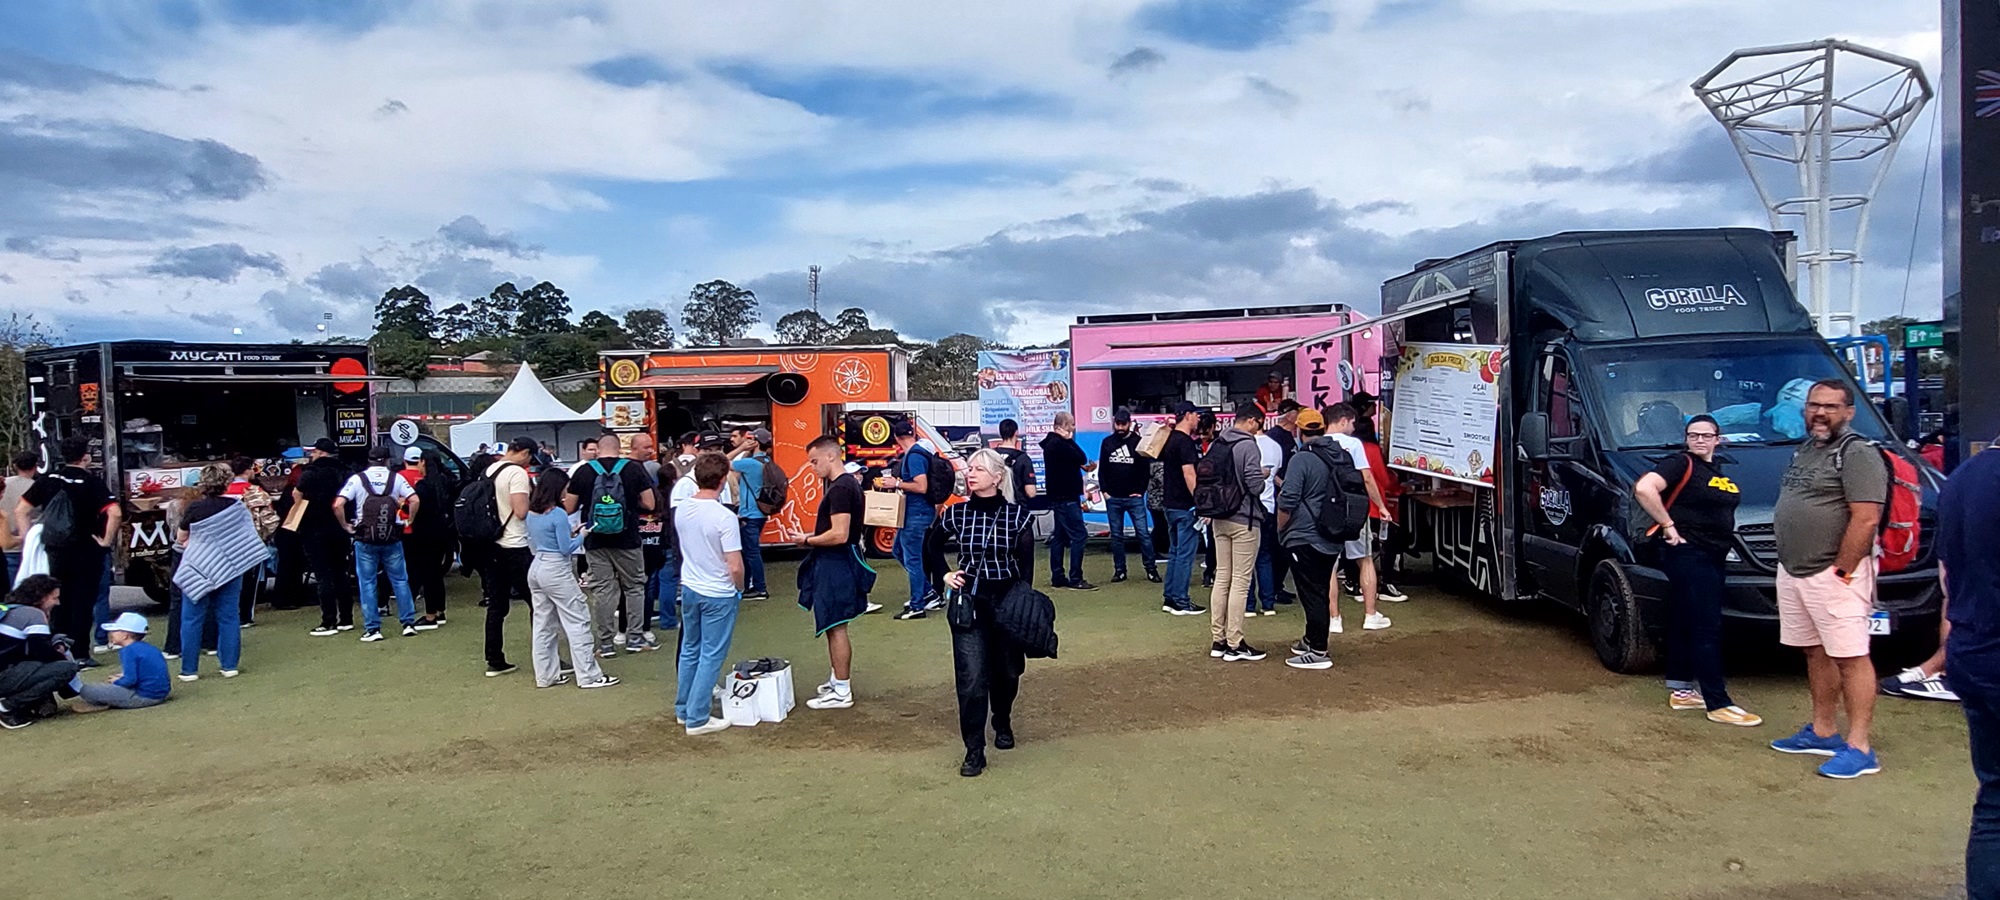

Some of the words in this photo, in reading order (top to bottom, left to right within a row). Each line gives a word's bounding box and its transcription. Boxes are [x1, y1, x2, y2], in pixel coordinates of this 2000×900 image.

[1645, 284, 1747, 311] GORILLA
[1698, 305, 1726, 313] TRUCK
[376, 503, 389, 540] adidas
